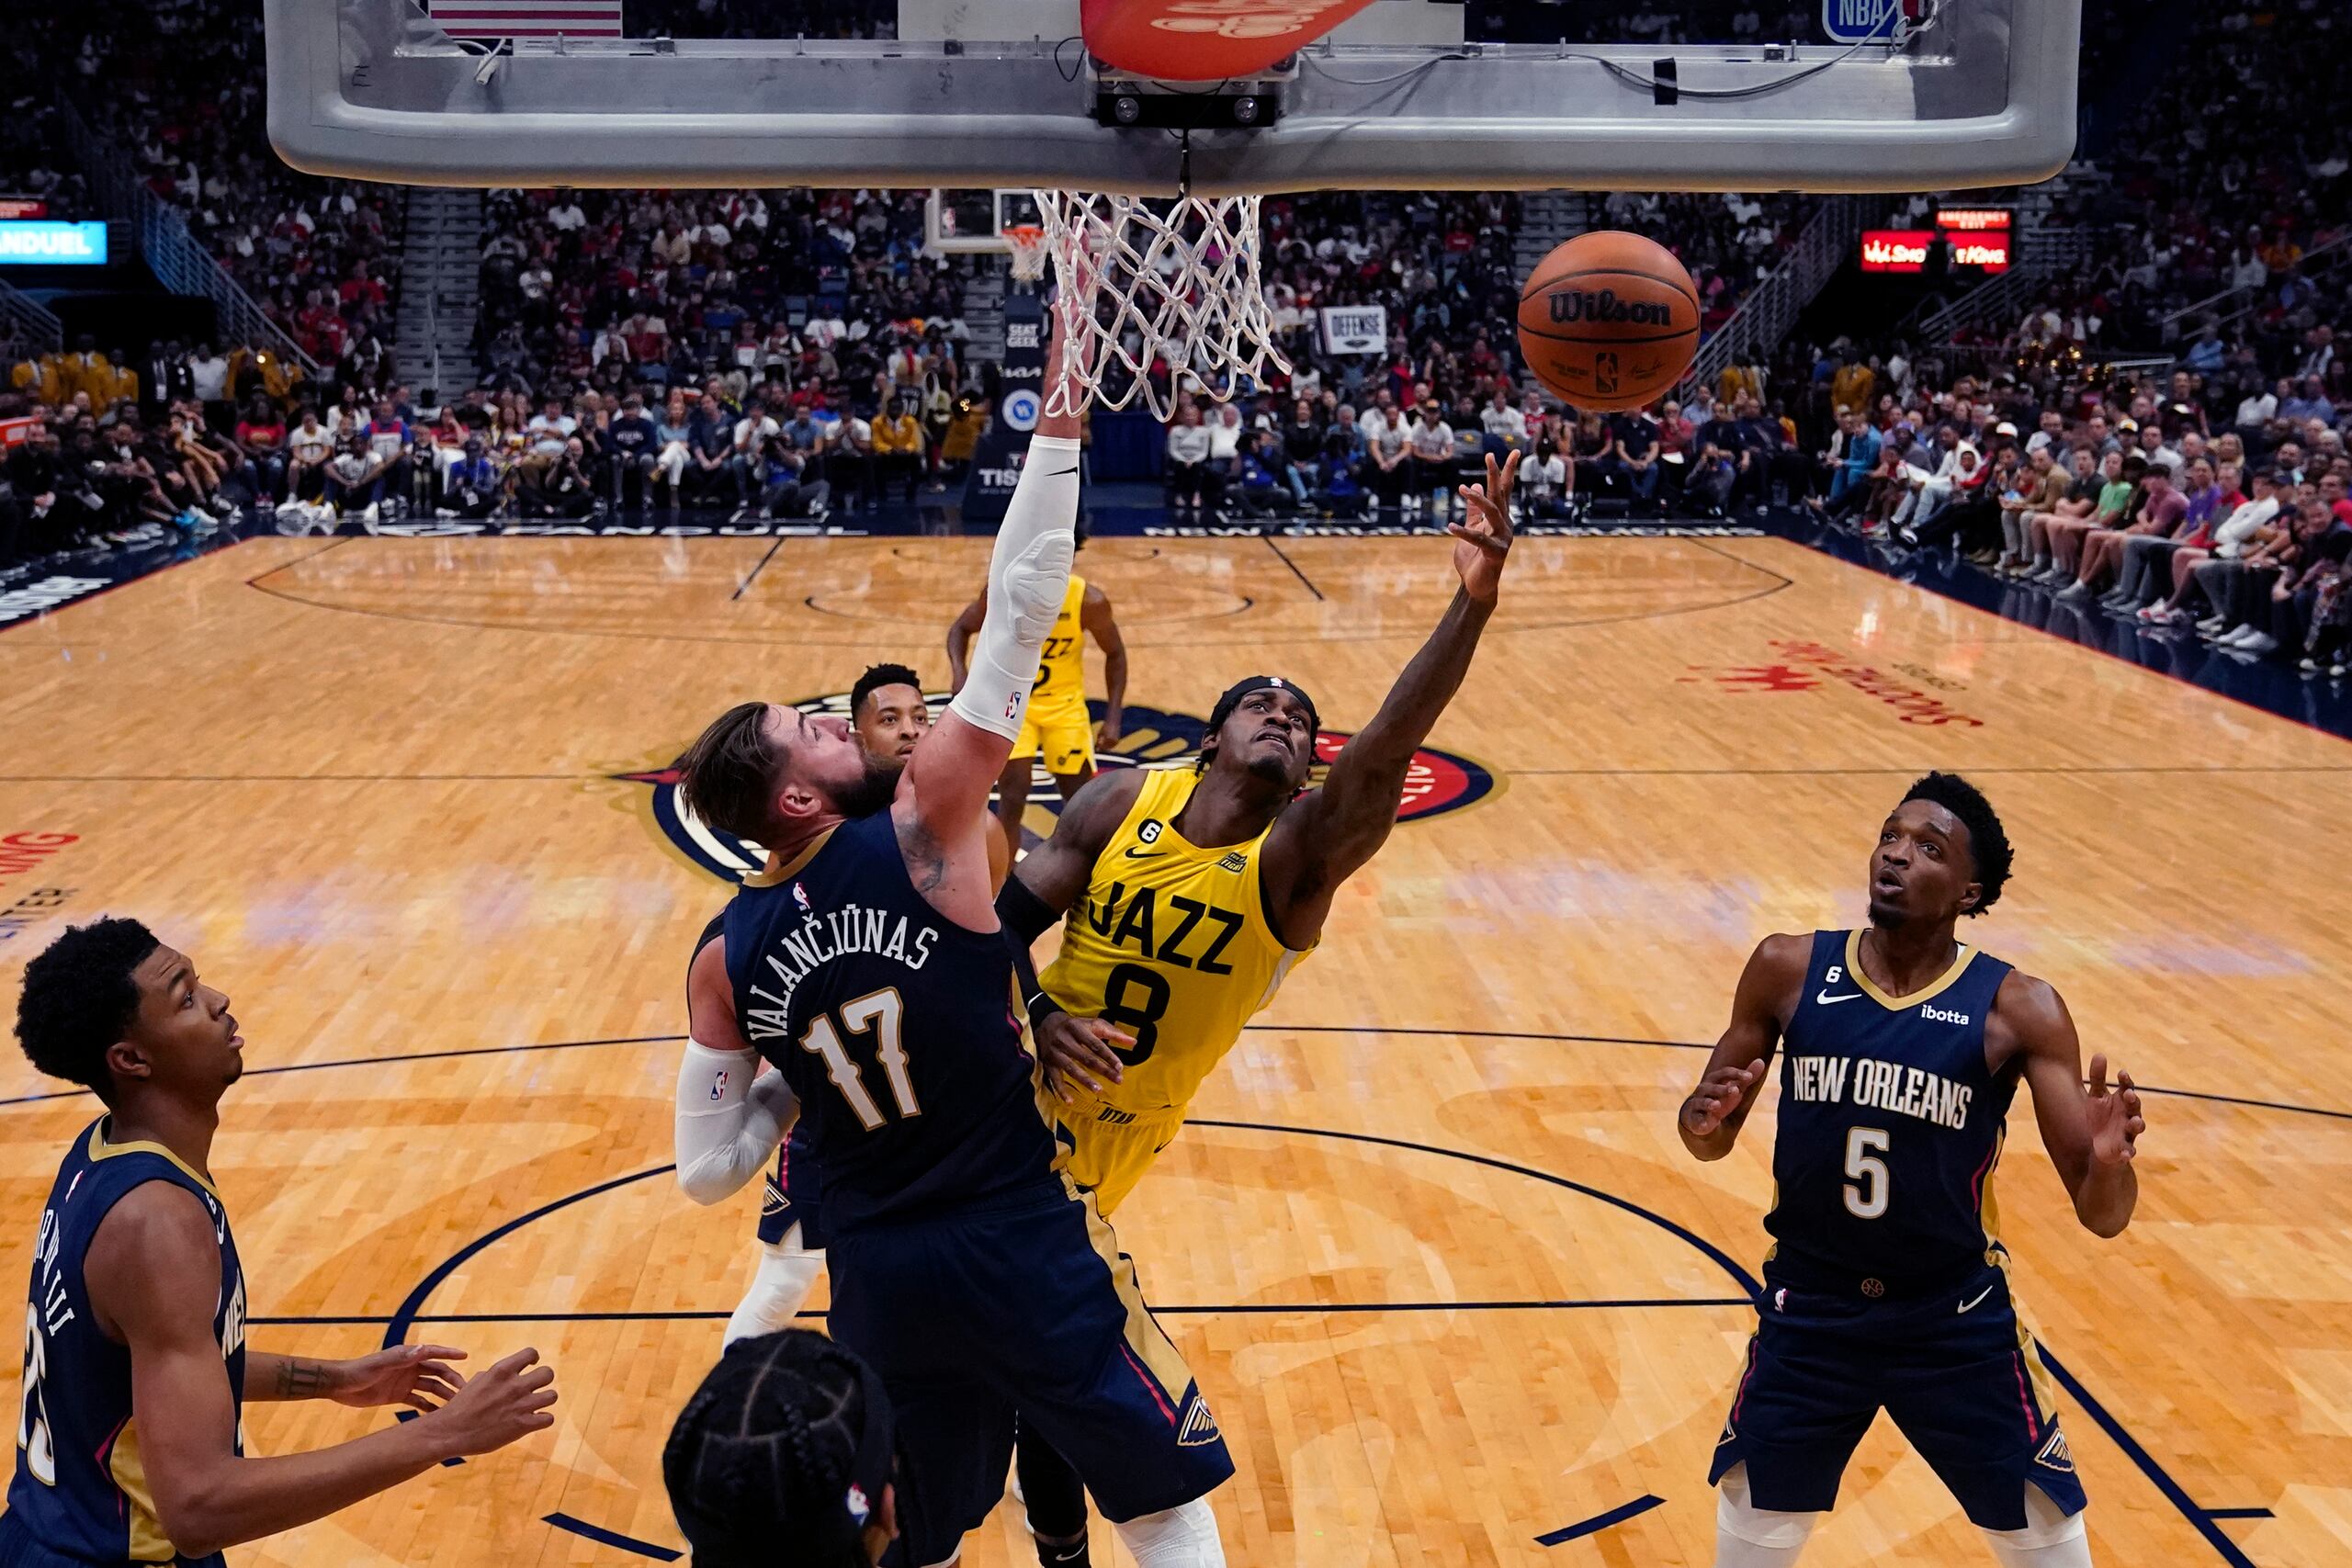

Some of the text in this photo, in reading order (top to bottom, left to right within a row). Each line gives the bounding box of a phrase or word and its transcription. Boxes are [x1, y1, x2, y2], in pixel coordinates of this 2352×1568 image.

[0, 230, 93, 254] NDUEL
[1549, 288, 1670, 325] Wilson
[1009, 324, 1037, 336] SEAT
[1331, 315, 1380, 337] DEFENSE
[1007, 336, 1039, 348] GEEK
[978, 468, 1020, 486] TIS
[1043, 637, 1074, 659] ZZ
[1141, 822, 1160, 842] 6
[1089, 882, 1245, 976] JAZZ
[748, 904, 939, 1041] VALANČIŪNAS
[1825, 965, 1842, 984] 6
[1097, 963, 1171, 1067] 8
[1921, 1004, 1970, 1026] ibotta
[798, 986, 922, 1133] 17
[1792, 1055, 1973, 1131] NEW ORLEANS
[1098, 1106, 1137, 1126] UTAH
[1843, 1125, 1890, 1220] 5
